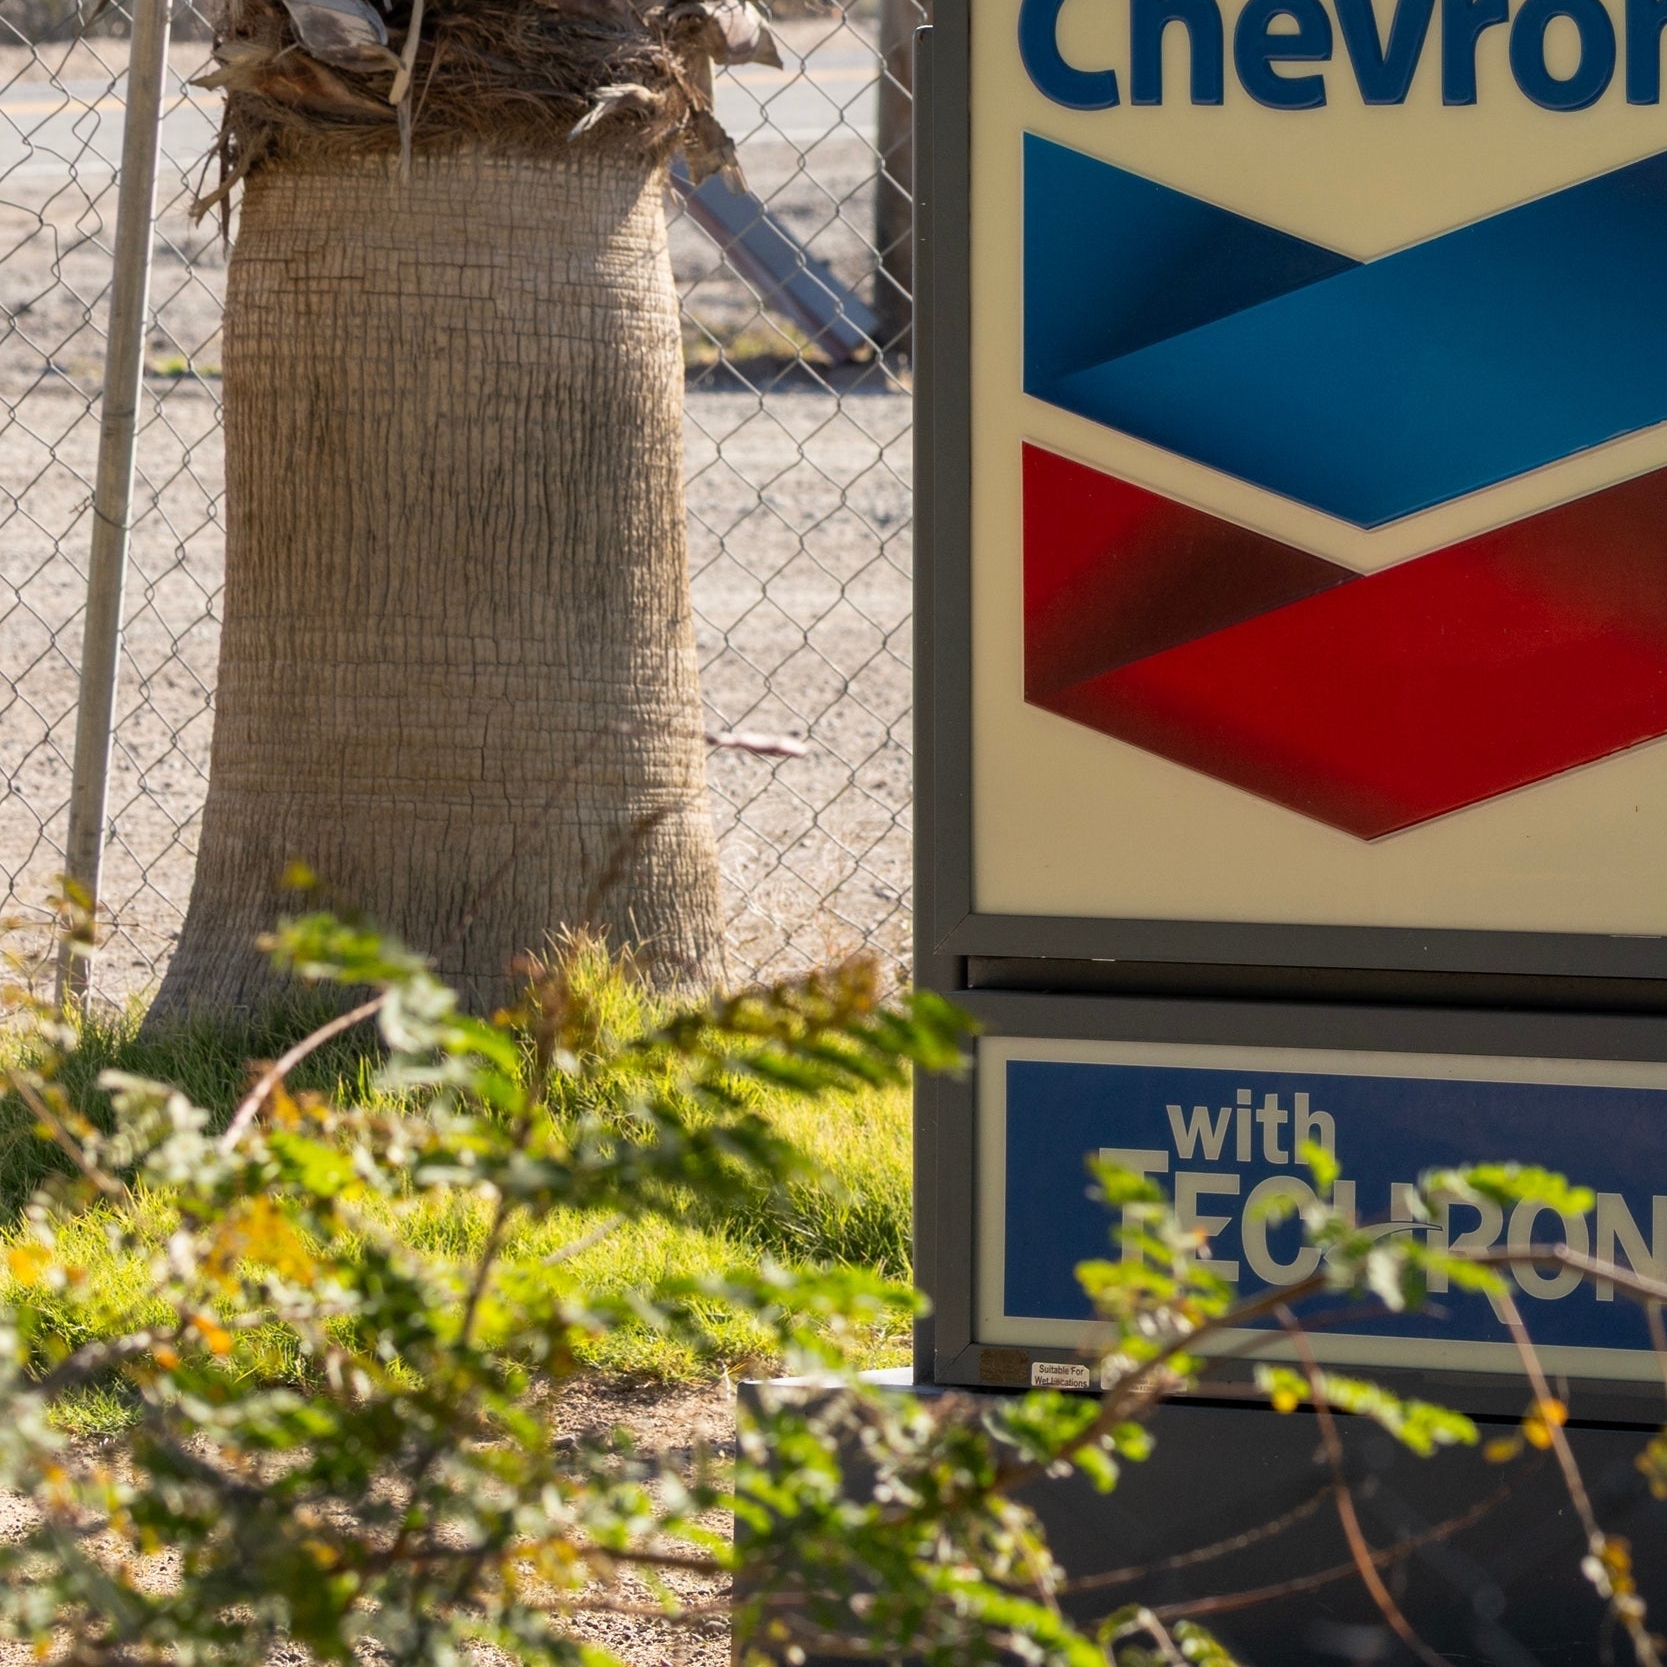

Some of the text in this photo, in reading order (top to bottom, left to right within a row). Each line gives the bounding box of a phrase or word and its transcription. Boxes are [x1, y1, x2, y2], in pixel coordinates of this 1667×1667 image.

[1166, 1089, 1336, 1165] with
[1039, 1365, 1084, 1376] Suitable For
[1035, 1376, 1049, 1385] Wet
